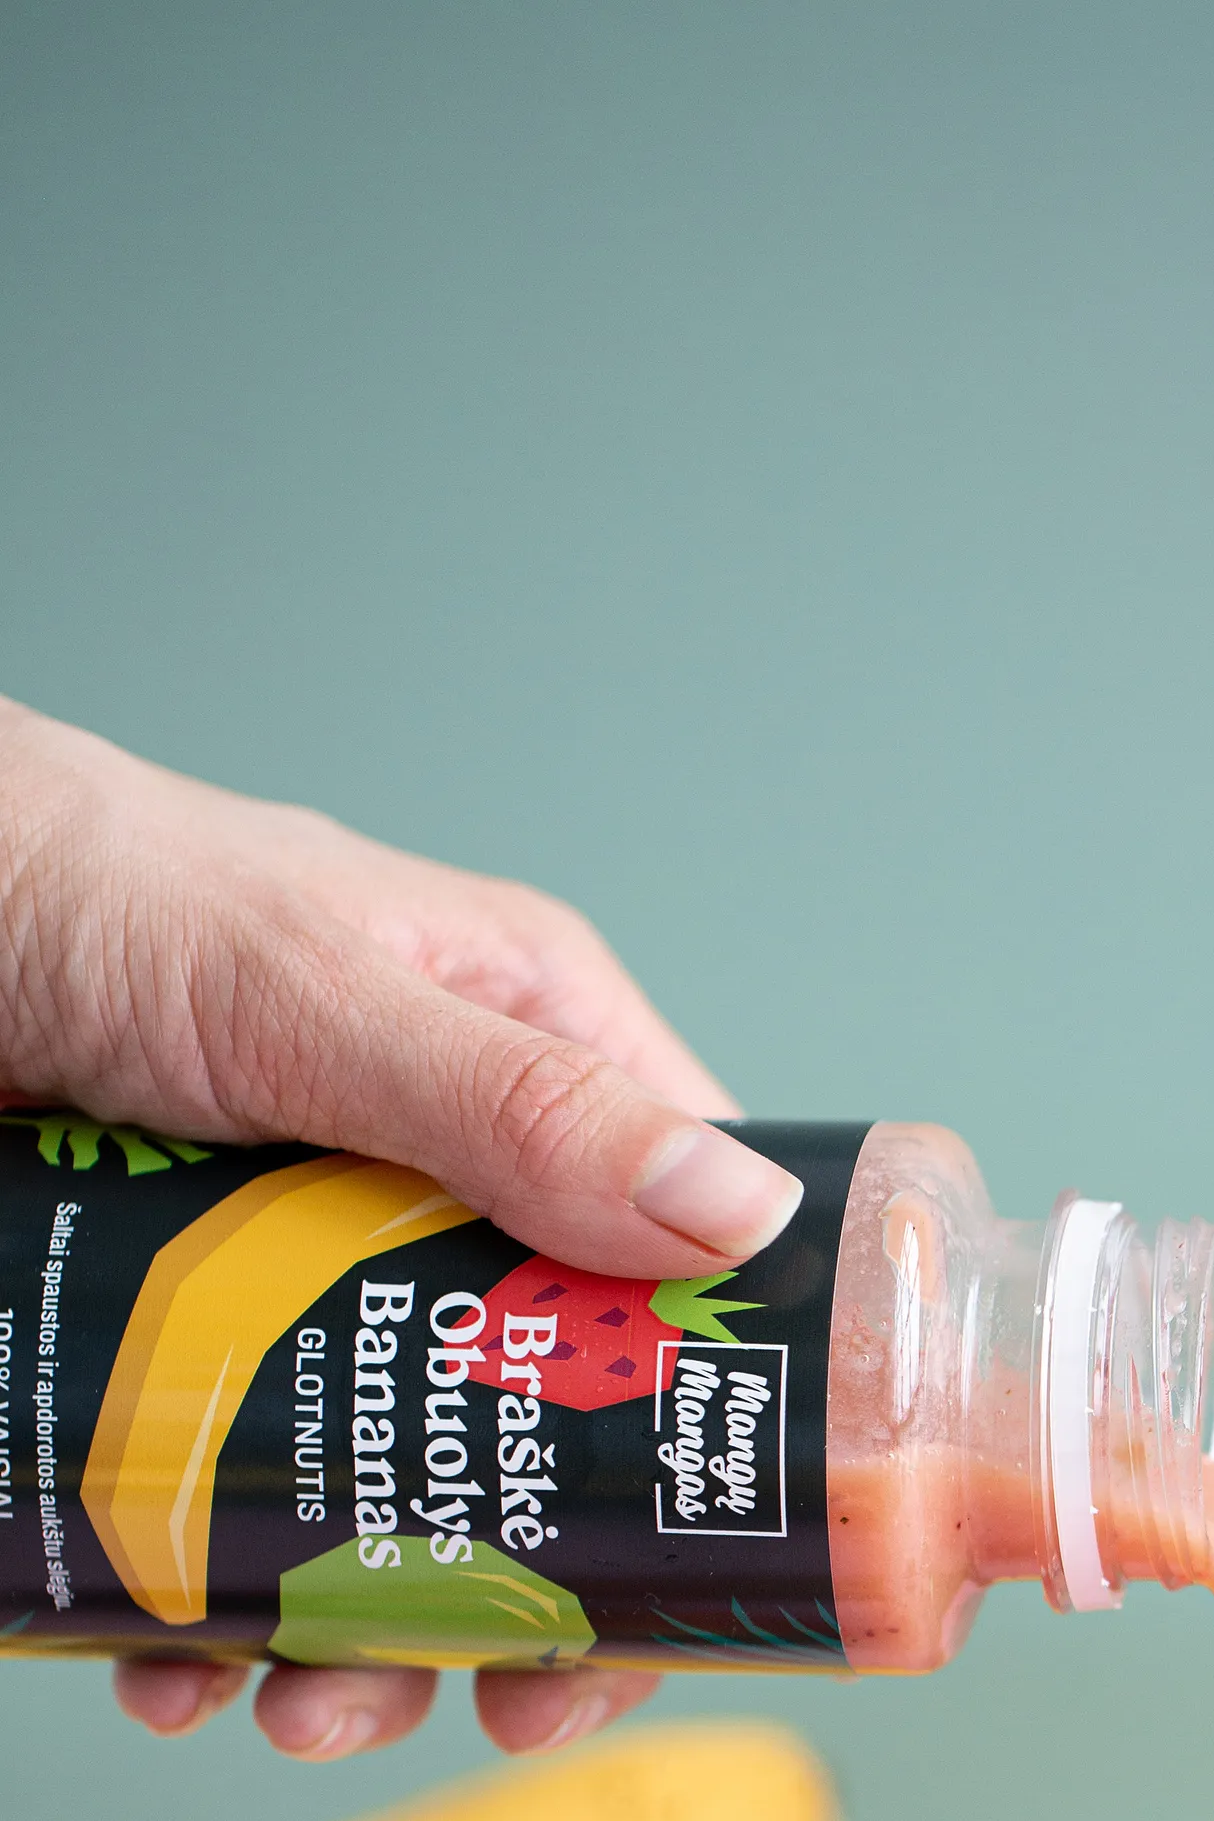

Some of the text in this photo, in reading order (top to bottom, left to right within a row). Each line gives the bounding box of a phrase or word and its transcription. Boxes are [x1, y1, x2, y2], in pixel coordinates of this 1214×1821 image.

[48, 1201, 82, 1257] Šaltai
[37, 1361, 60, 1377] ir
[38, 1260, 63, 1357] spaustos
[32, 1380, 58, 1490] apdorotos
[294, 1327, 326, 1523] GLOTNUTIS
[352, 1279, 415, 1569] Bananas
[410, 1291, 487, 1564] Obuolys
[498, 1311, 559, 1550] Braškė
[657, 1358, 721, 1522] Mangas
[708, 1371, 772, 1515] Mangų
[38, 1493, 65, 1558] aukštu
